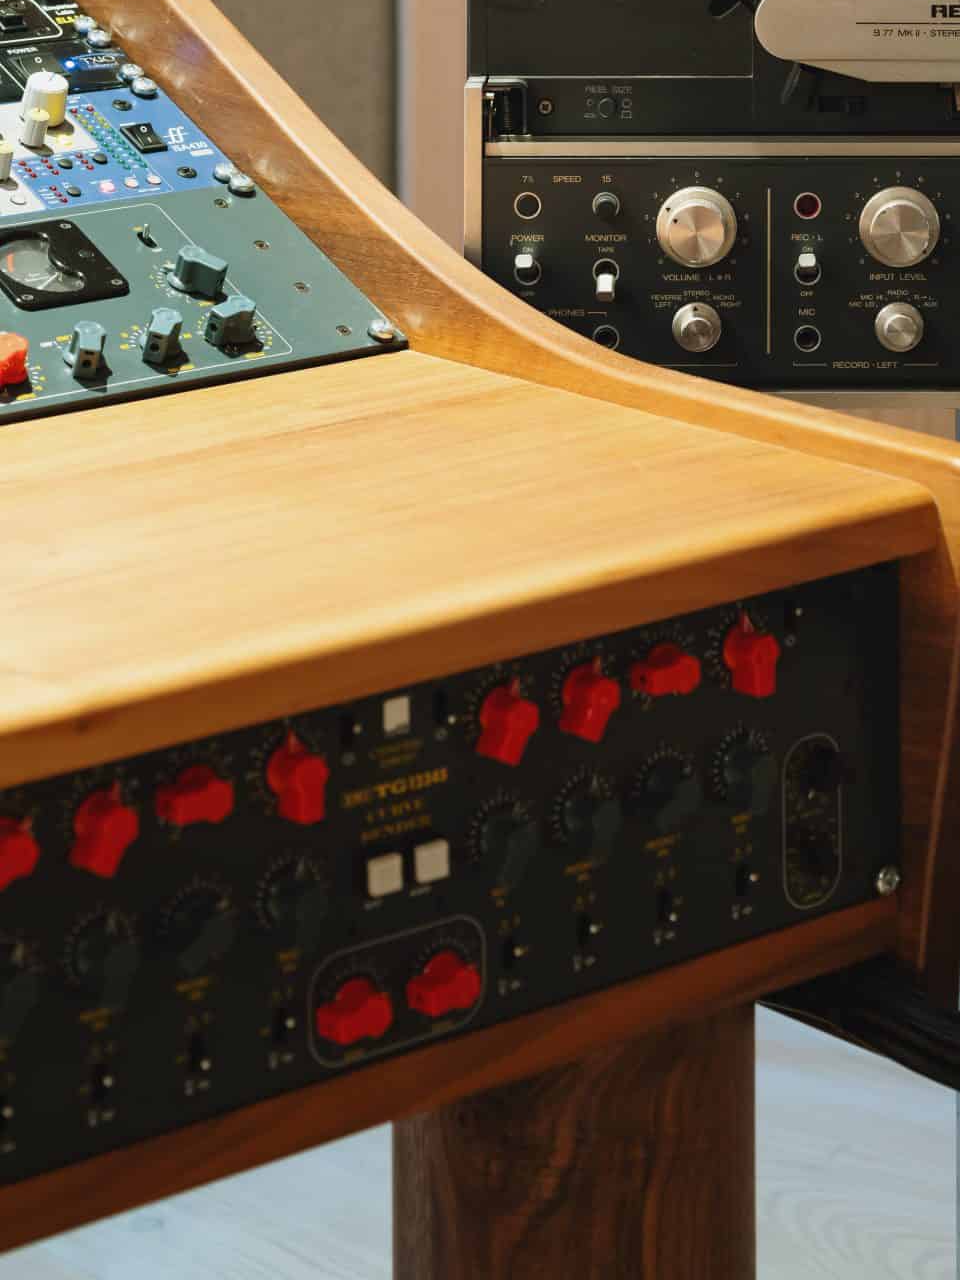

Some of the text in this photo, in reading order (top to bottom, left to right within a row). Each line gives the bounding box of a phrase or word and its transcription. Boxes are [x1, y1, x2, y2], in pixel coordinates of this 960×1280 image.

[552, 175, 583, 183] SPEED
[601, 175, 612, 183] 15
[511, 234, 544, 242] POWER
[584, 234, 627, 242] MONITOR
[869, 273, 927, 281] INPUT LEVEL
[799, 308, 816, 316] MIC
[832, 361, 898, 369] RECORD LEFT
